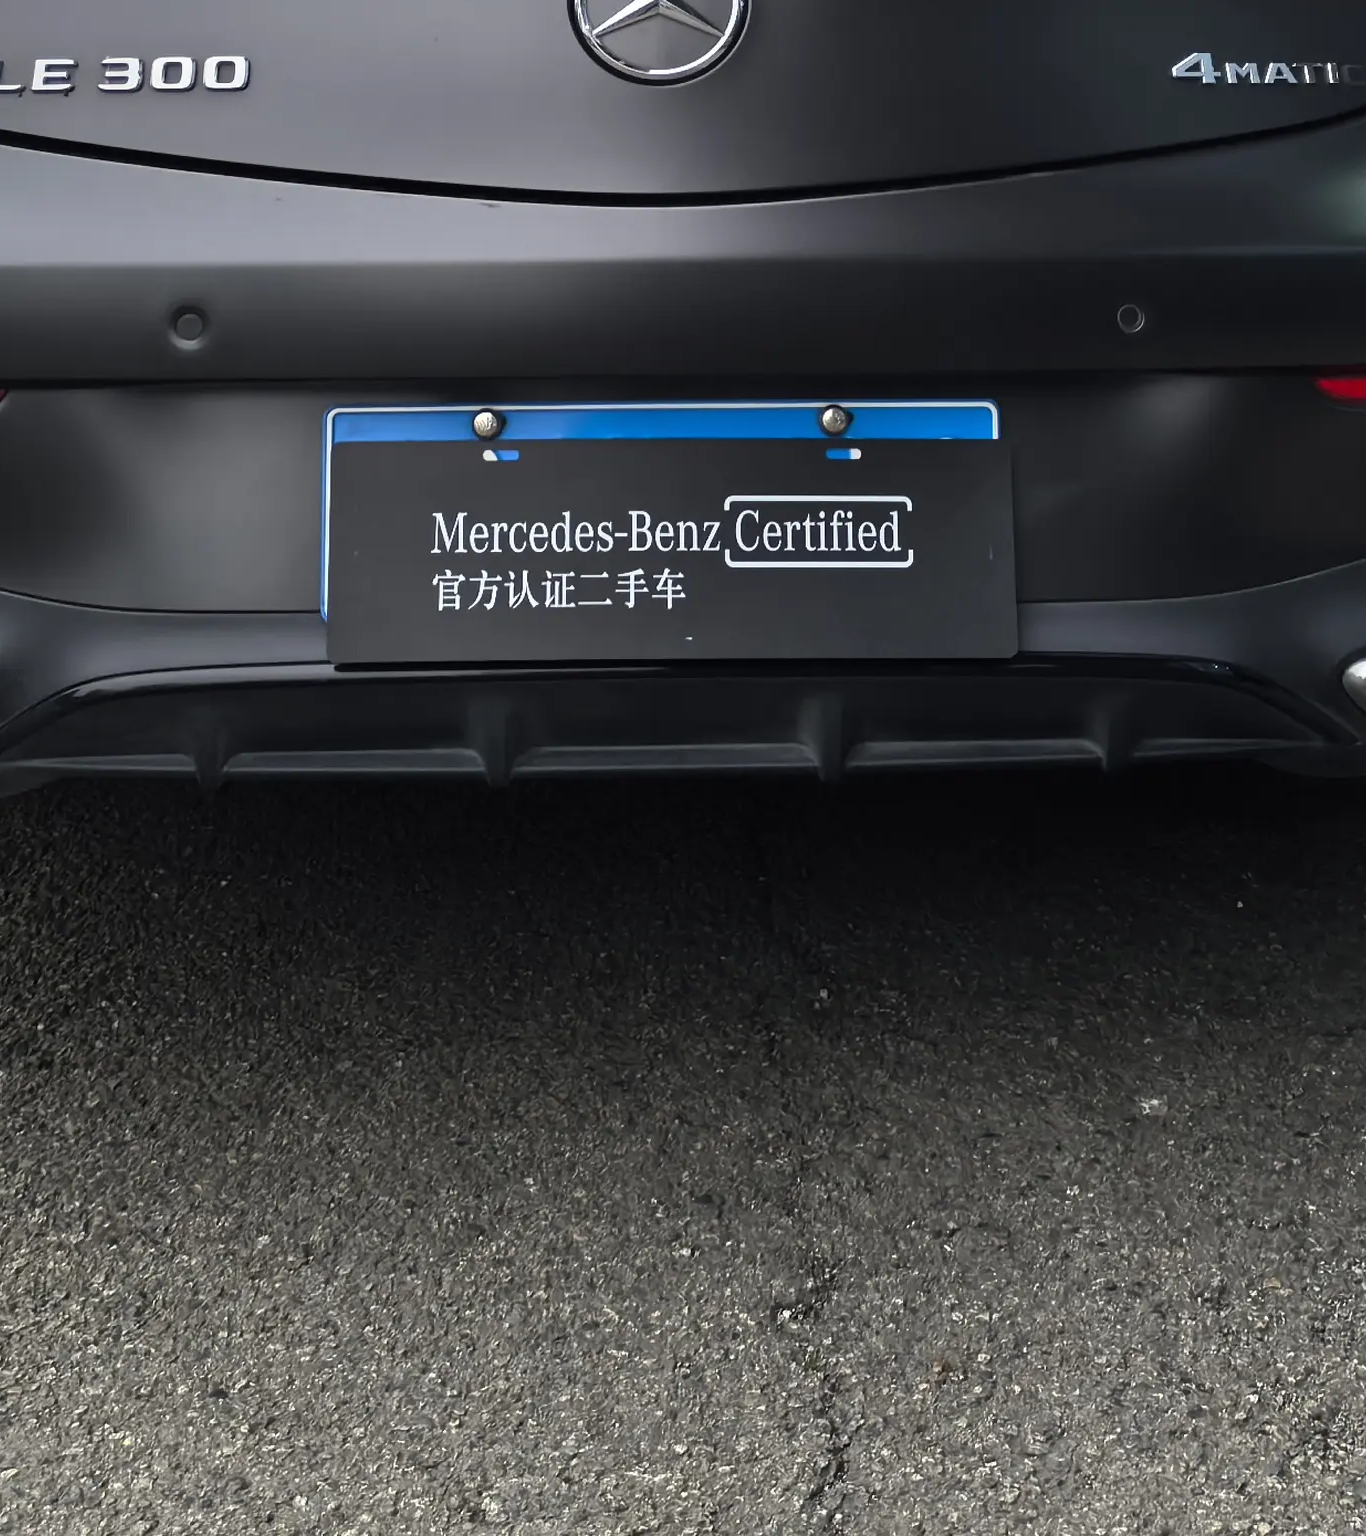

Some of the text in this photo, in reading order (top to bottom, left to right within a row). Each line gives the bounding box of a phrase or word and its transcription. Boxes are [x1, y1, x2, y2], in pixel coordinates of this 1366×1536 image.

[97, 56, 249, 91] 300
[1171, 52, 1366, 86] 4MATIC
[431, 509, 902, 554] Mercedes-Benz Certified
[432, 568, 686, 612] 官方认证二手车
